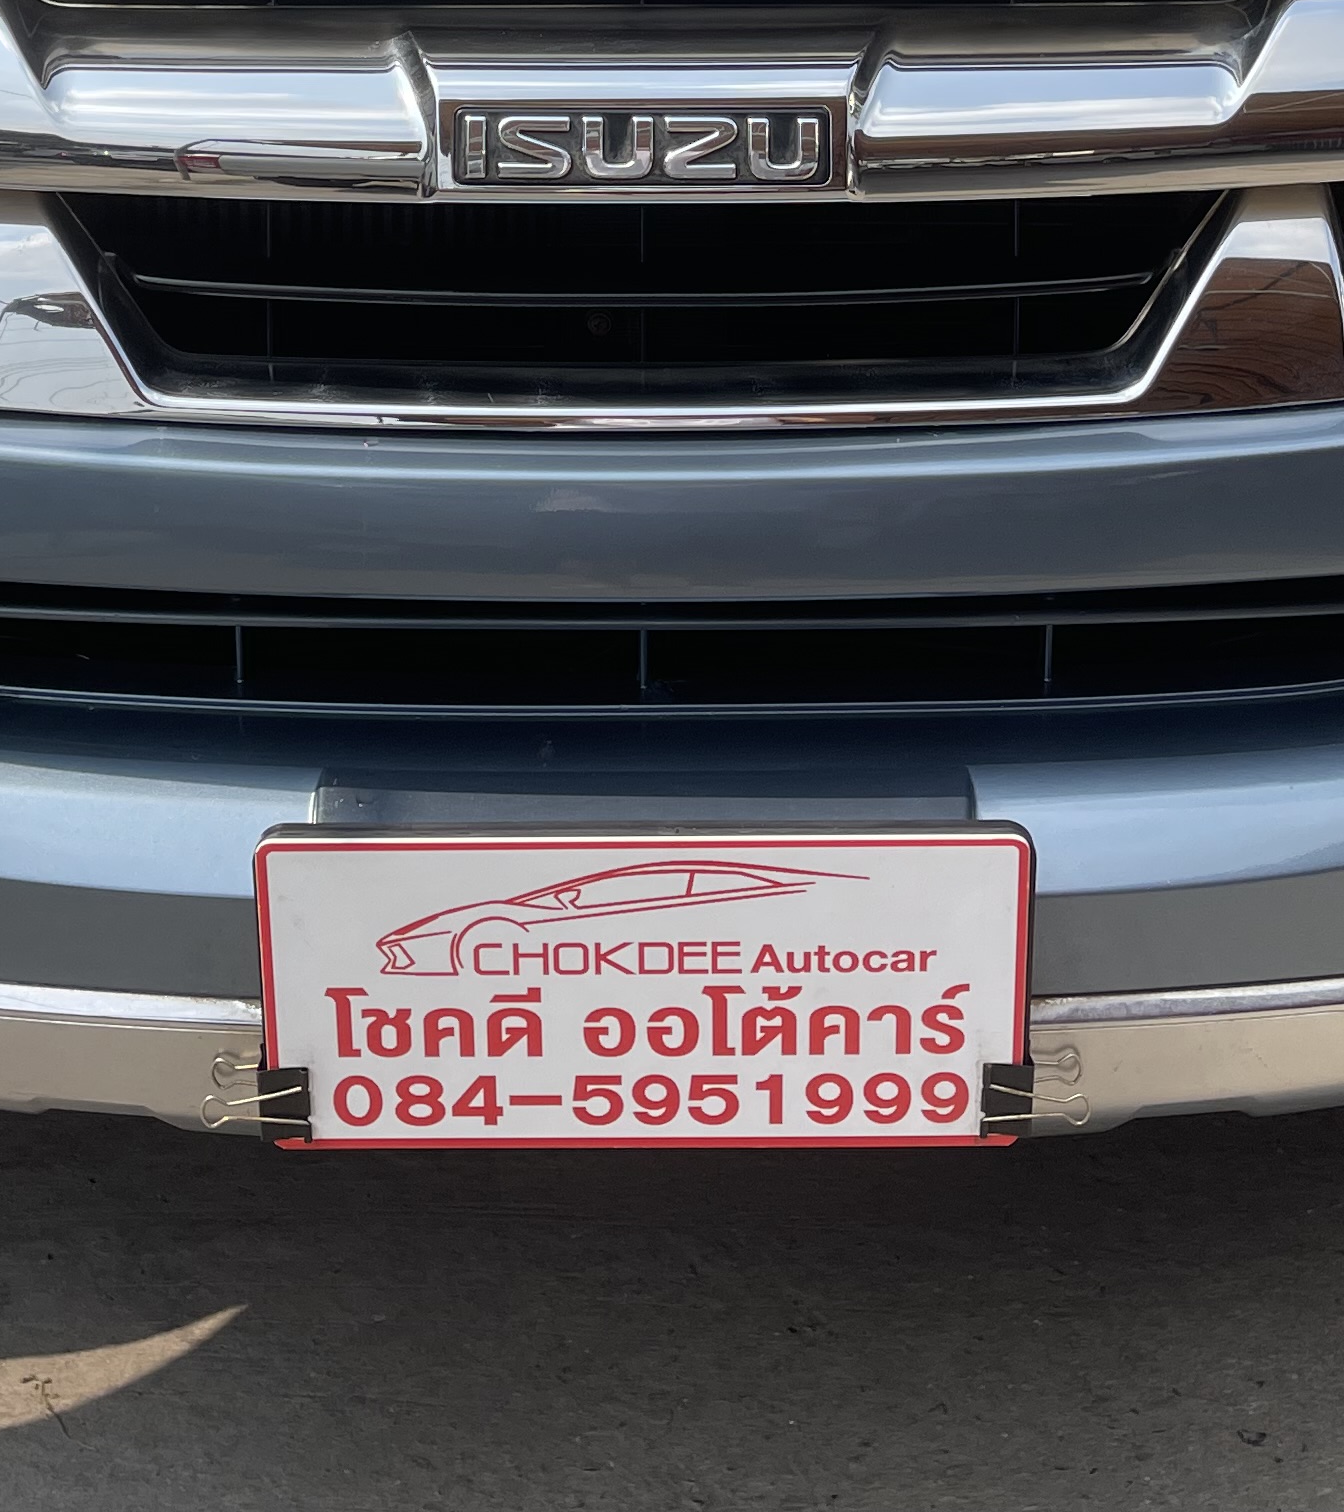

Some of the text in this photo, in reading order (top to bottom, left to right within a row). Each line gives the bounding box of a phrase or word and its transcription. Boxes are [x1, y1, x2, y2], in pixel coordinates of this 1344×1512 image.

[464, 115, 820, 181] ISUZU
[472, 940, 937, 977] CHOKDEE Autocar
[325, 983, 970, 1058] โชคดี ออโต้คาร์
[333, 1071, 970, 1127] 084-5951999
